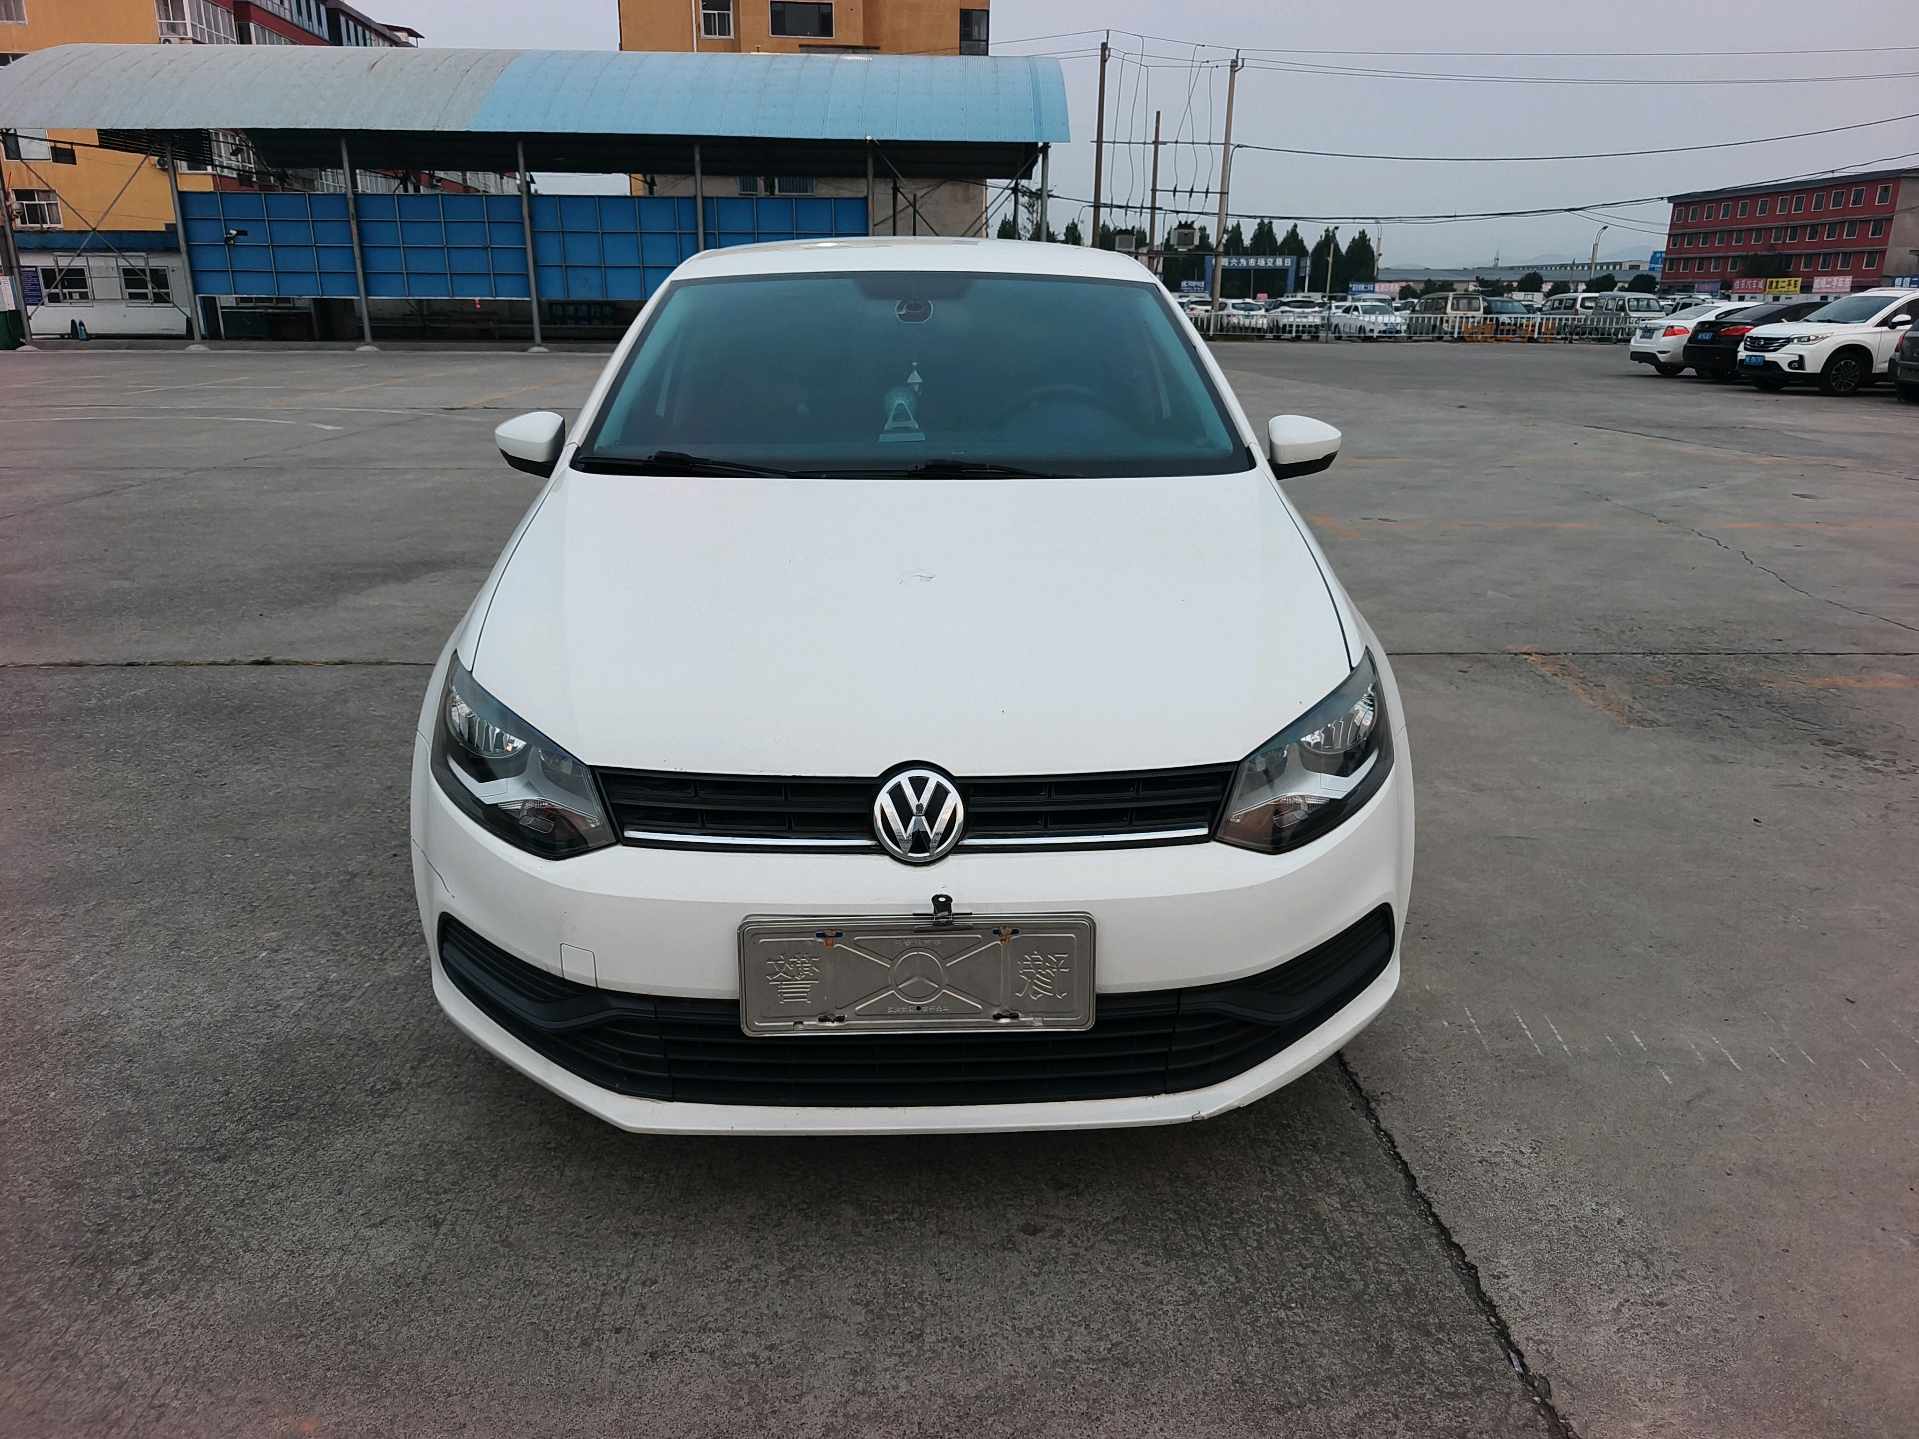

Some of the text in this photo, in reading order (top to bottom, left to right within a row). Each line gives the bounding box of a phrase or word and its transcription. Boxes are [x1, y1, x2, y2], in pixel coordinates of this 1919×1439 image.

[1212, 257, 1292, 267] 周六为市场交易日
[874, 770, 964, 862] VW
